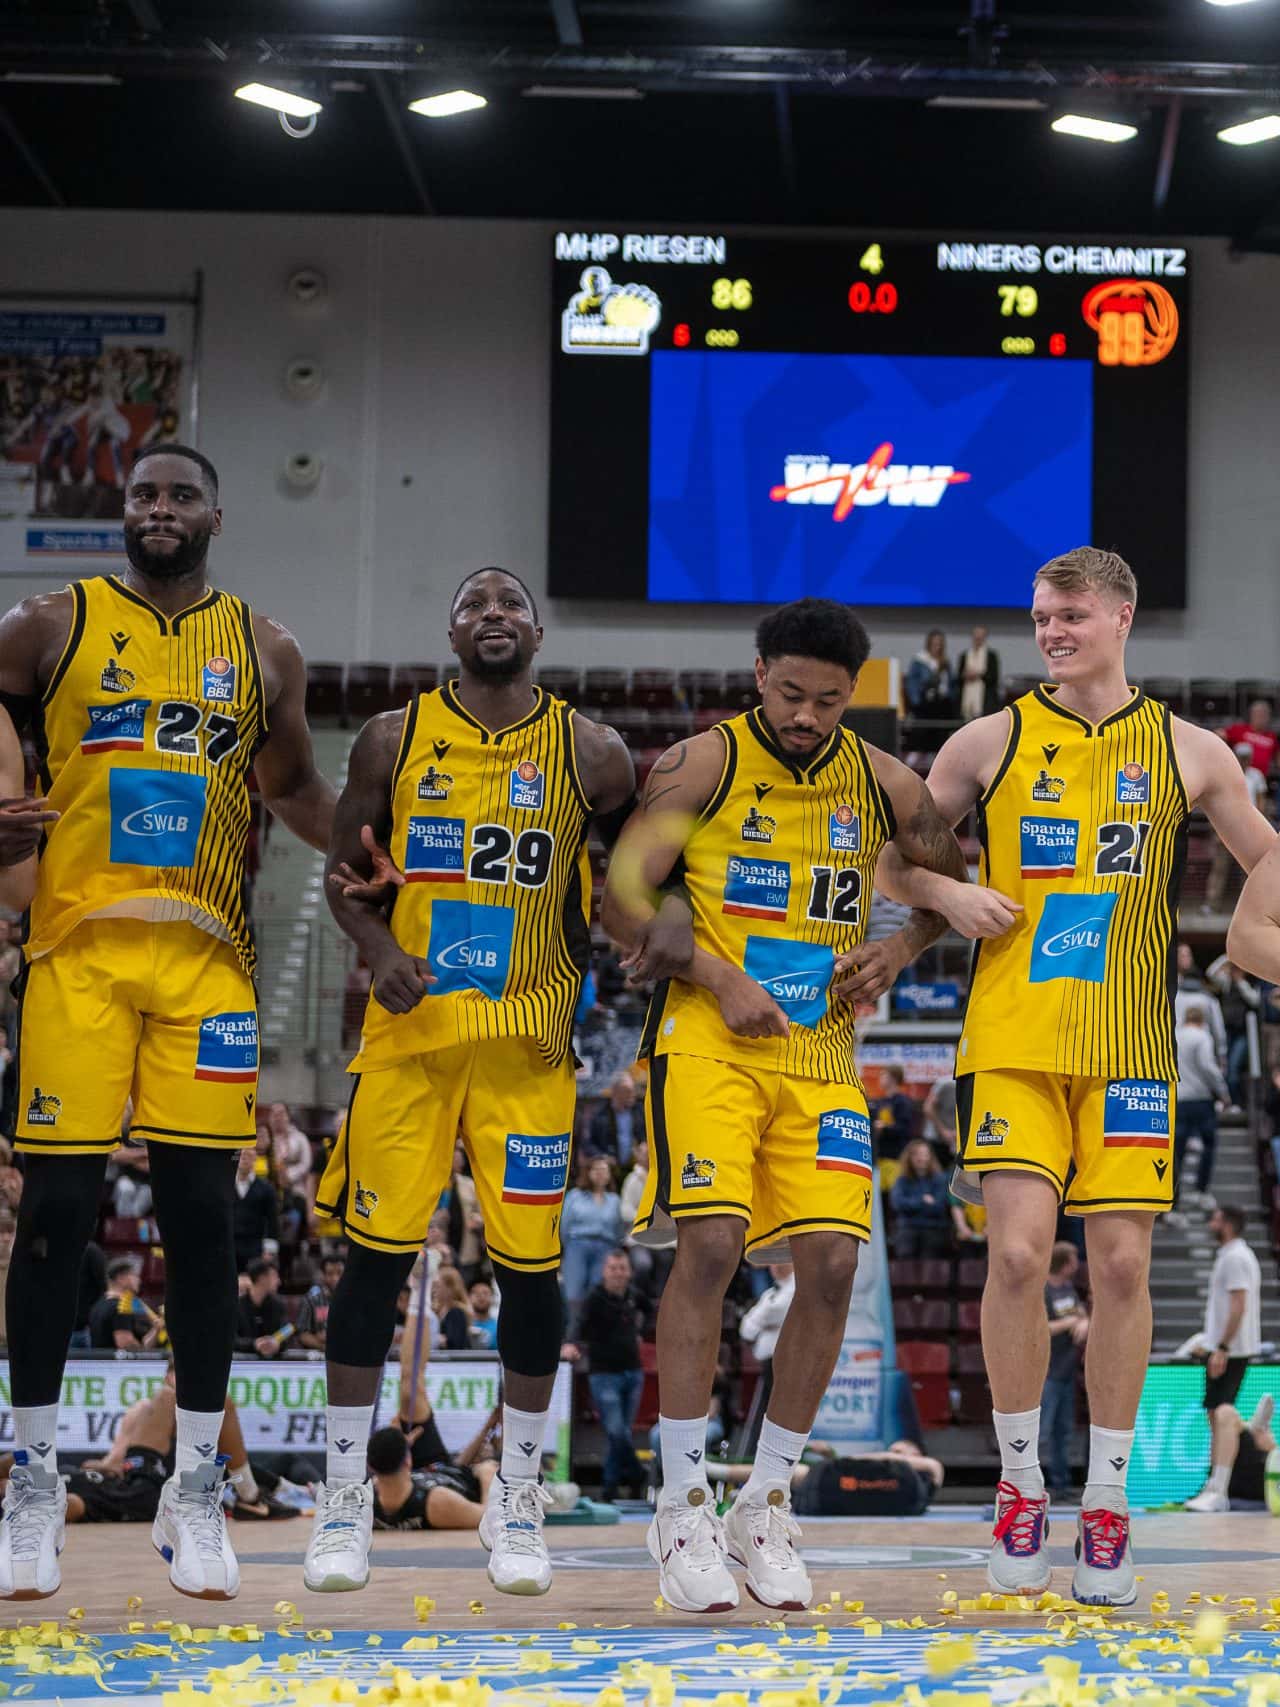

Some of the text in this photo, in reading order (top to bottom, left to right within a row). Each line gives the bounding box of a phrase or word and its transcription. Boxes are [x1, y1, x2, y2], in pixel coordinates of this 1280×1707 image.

[555, 232, 727, 264] MHP RIESEN
[859, 243, 884, 275] 4
[936, 242, 1187, 276] NINERS CHEMNITZ
[711, 277, 753, 311] 86
[848, 280, 899, 313] 0.0
[998, 284, 1038, 317] 79
[206, 687, 231, 698] BBL
[120, 720, 143, 735] BW
[154, 701, 240, 766] 27
[513, 793, 538, 805] BBL
[1120, 790, 1144, 801] BBL
[143, 814, 189, 832] SWLB
[407, 821, 463, 837] Sparda
[1022, 821, 1076, 836] Sparda
[422, 836, 464, 849] Bank
[834, 837, 856, 848] BBL
[1036, 835, 1075, 847] Bank
[467, 823, 555, 889] 29
[728, 860, 788, 878] Sparda
[743, 875, 788, 888] Bank
[766, 892, 787, 904] BW
[806, 865, 862, 925] 12
[1061, 931, 1101, 949] SWLB
[772, 982, 819, 1001] SWLB
[202, 1017, 257, 1034] Sparda
[222, 1033, 257, 1046] Bank
[1108, 1084, 1168, 1100] Sparda
[1125, 1098, 1168, 1113] Bank
[822, 1115, 871, 1135] Sparda
[1151, 1118, 1168, 1130] BW
[508, 1139, 569, 1157] Sparda
[527, 1156, 568, 1169] Bank
